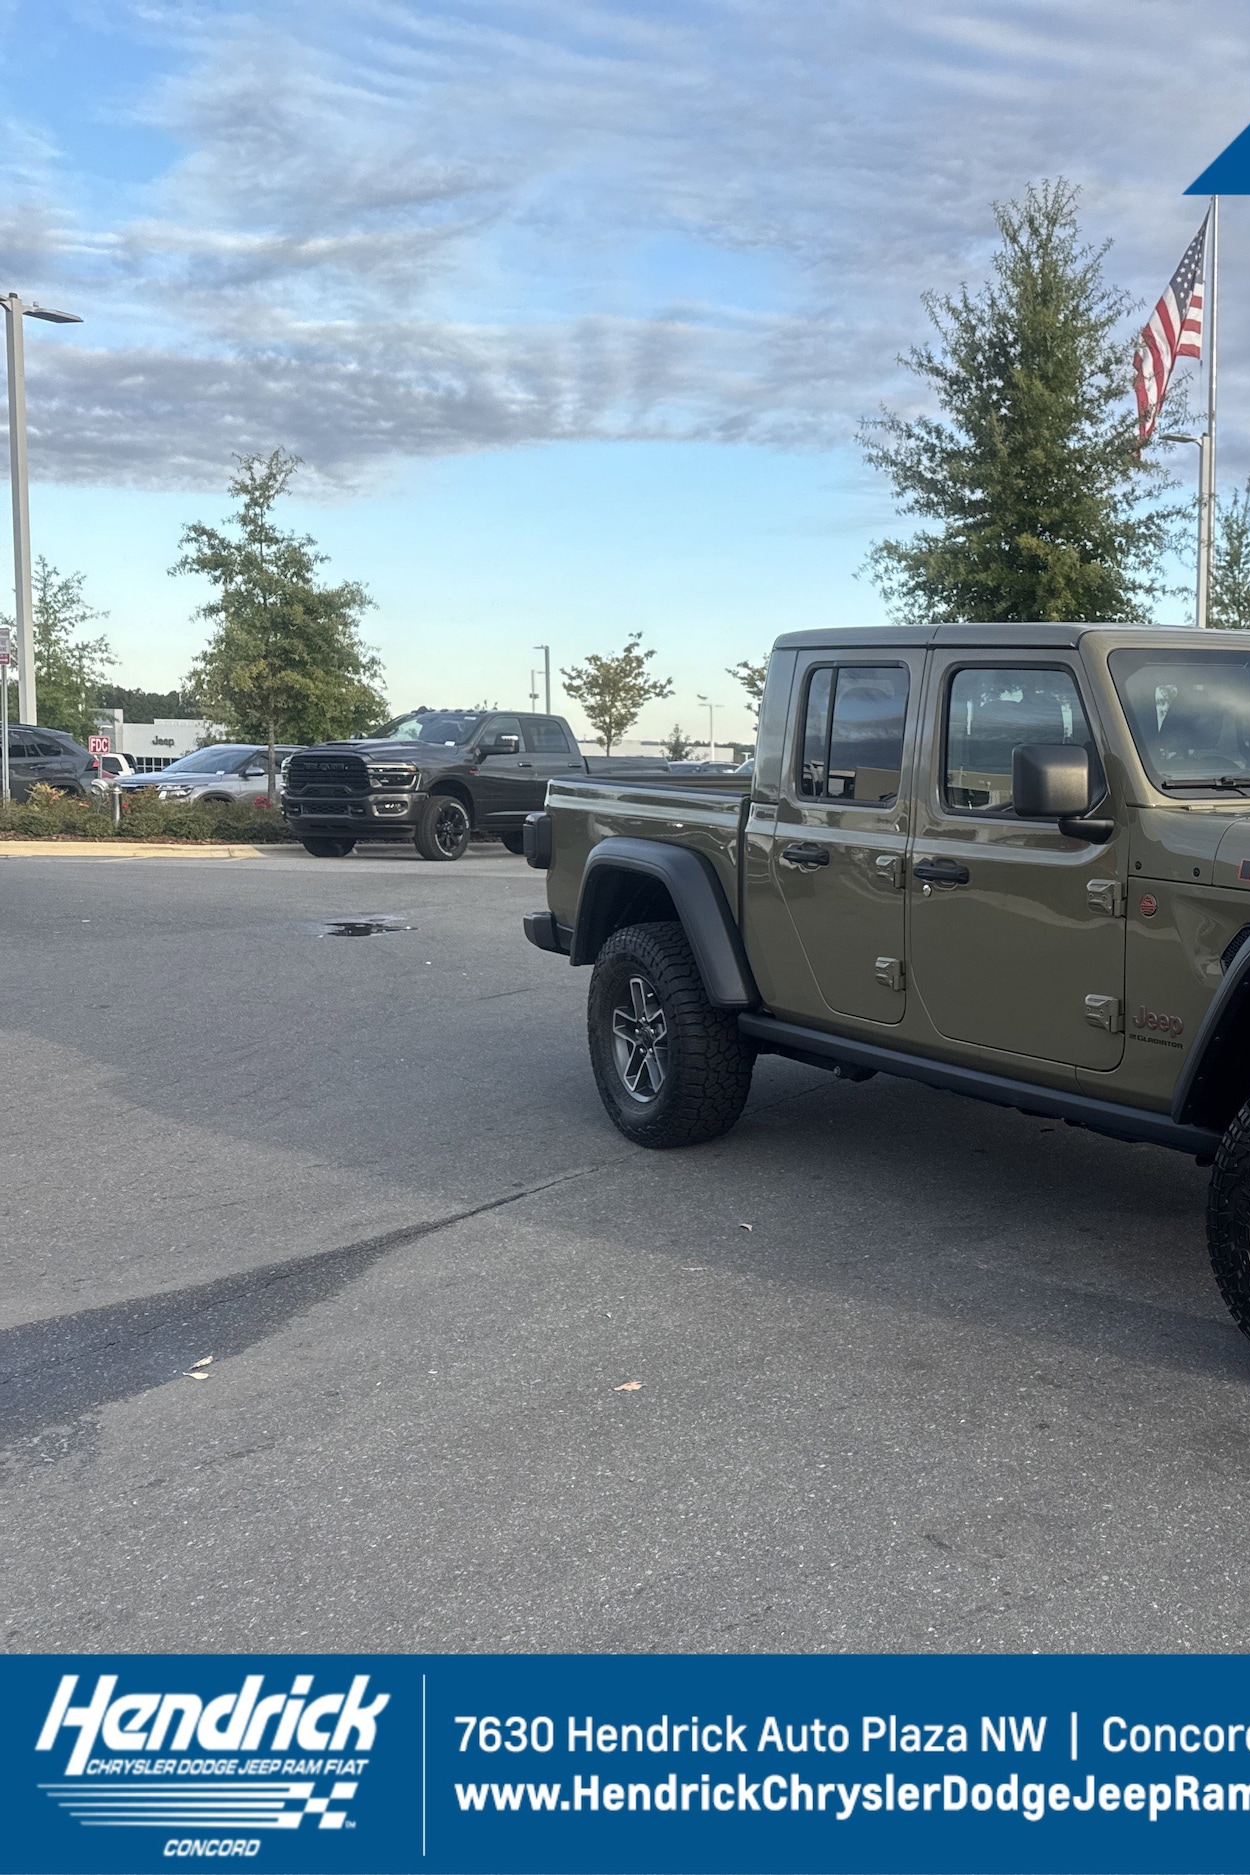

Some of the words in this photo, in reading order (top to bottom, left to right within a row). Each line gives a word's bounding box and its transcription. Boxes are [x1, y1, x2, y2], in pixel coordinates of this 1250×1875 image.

[90, 738, 109, 753] FDC
[152, 735, 175, 748] Jeep
[1133, 1005, 1184, 1038] Jeep
[1137, 1034, 1184, 1050] GLADIATOR
